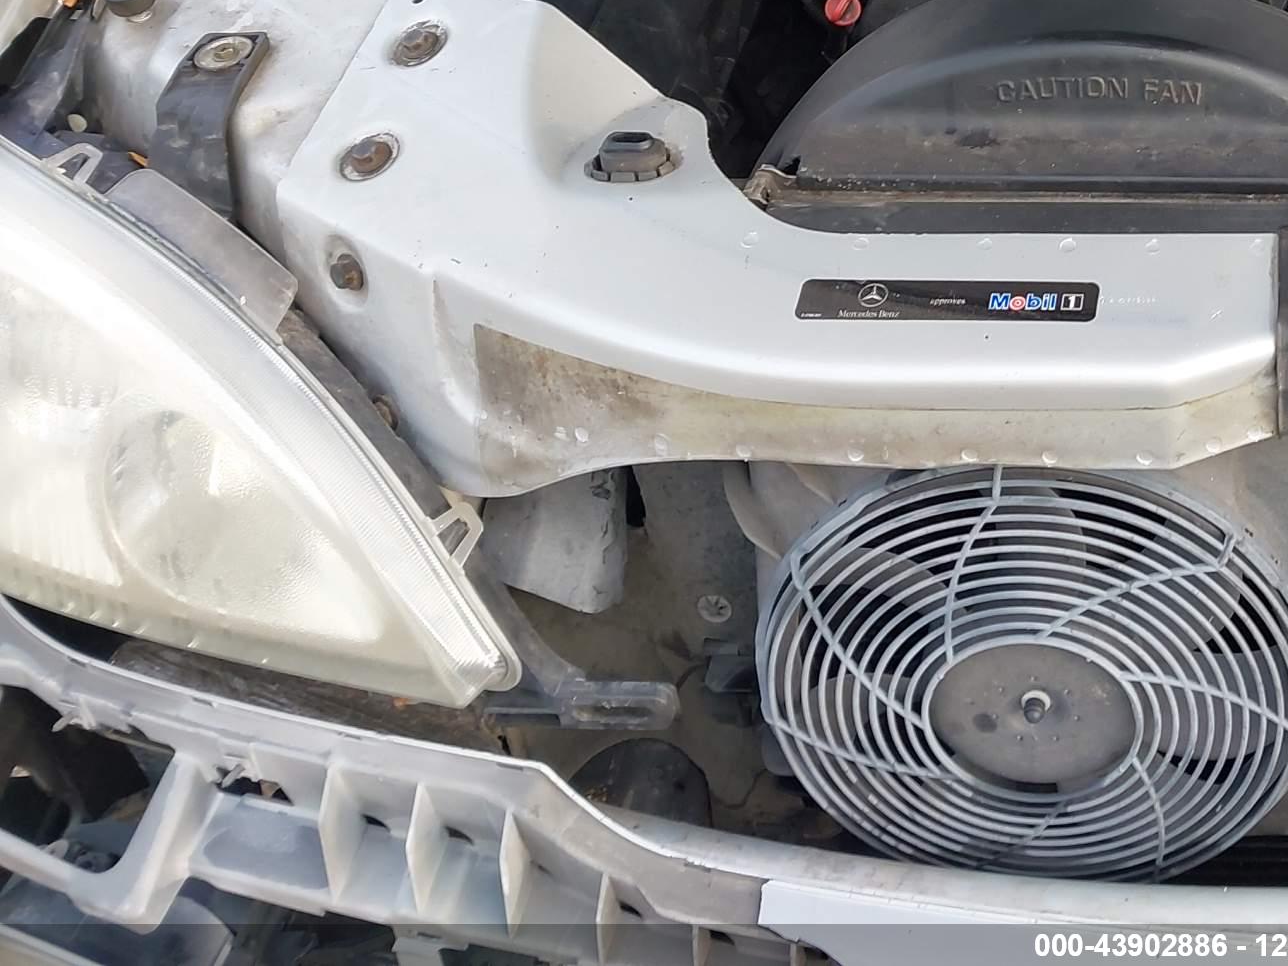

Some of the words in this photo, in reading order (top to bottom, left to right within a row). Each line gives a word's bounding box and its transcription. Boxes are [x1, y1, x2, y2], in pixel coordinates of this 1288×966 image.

[997, 76, 1129, 102] CAUTION
[1143, 78, 1203, 106] FAN
[929, 296, 966, 306] approves
[988, 292, 1057, 312] Mobil
[837, 309, 878, 318] Mercedes
[879, 309, 901, 318] Benz
